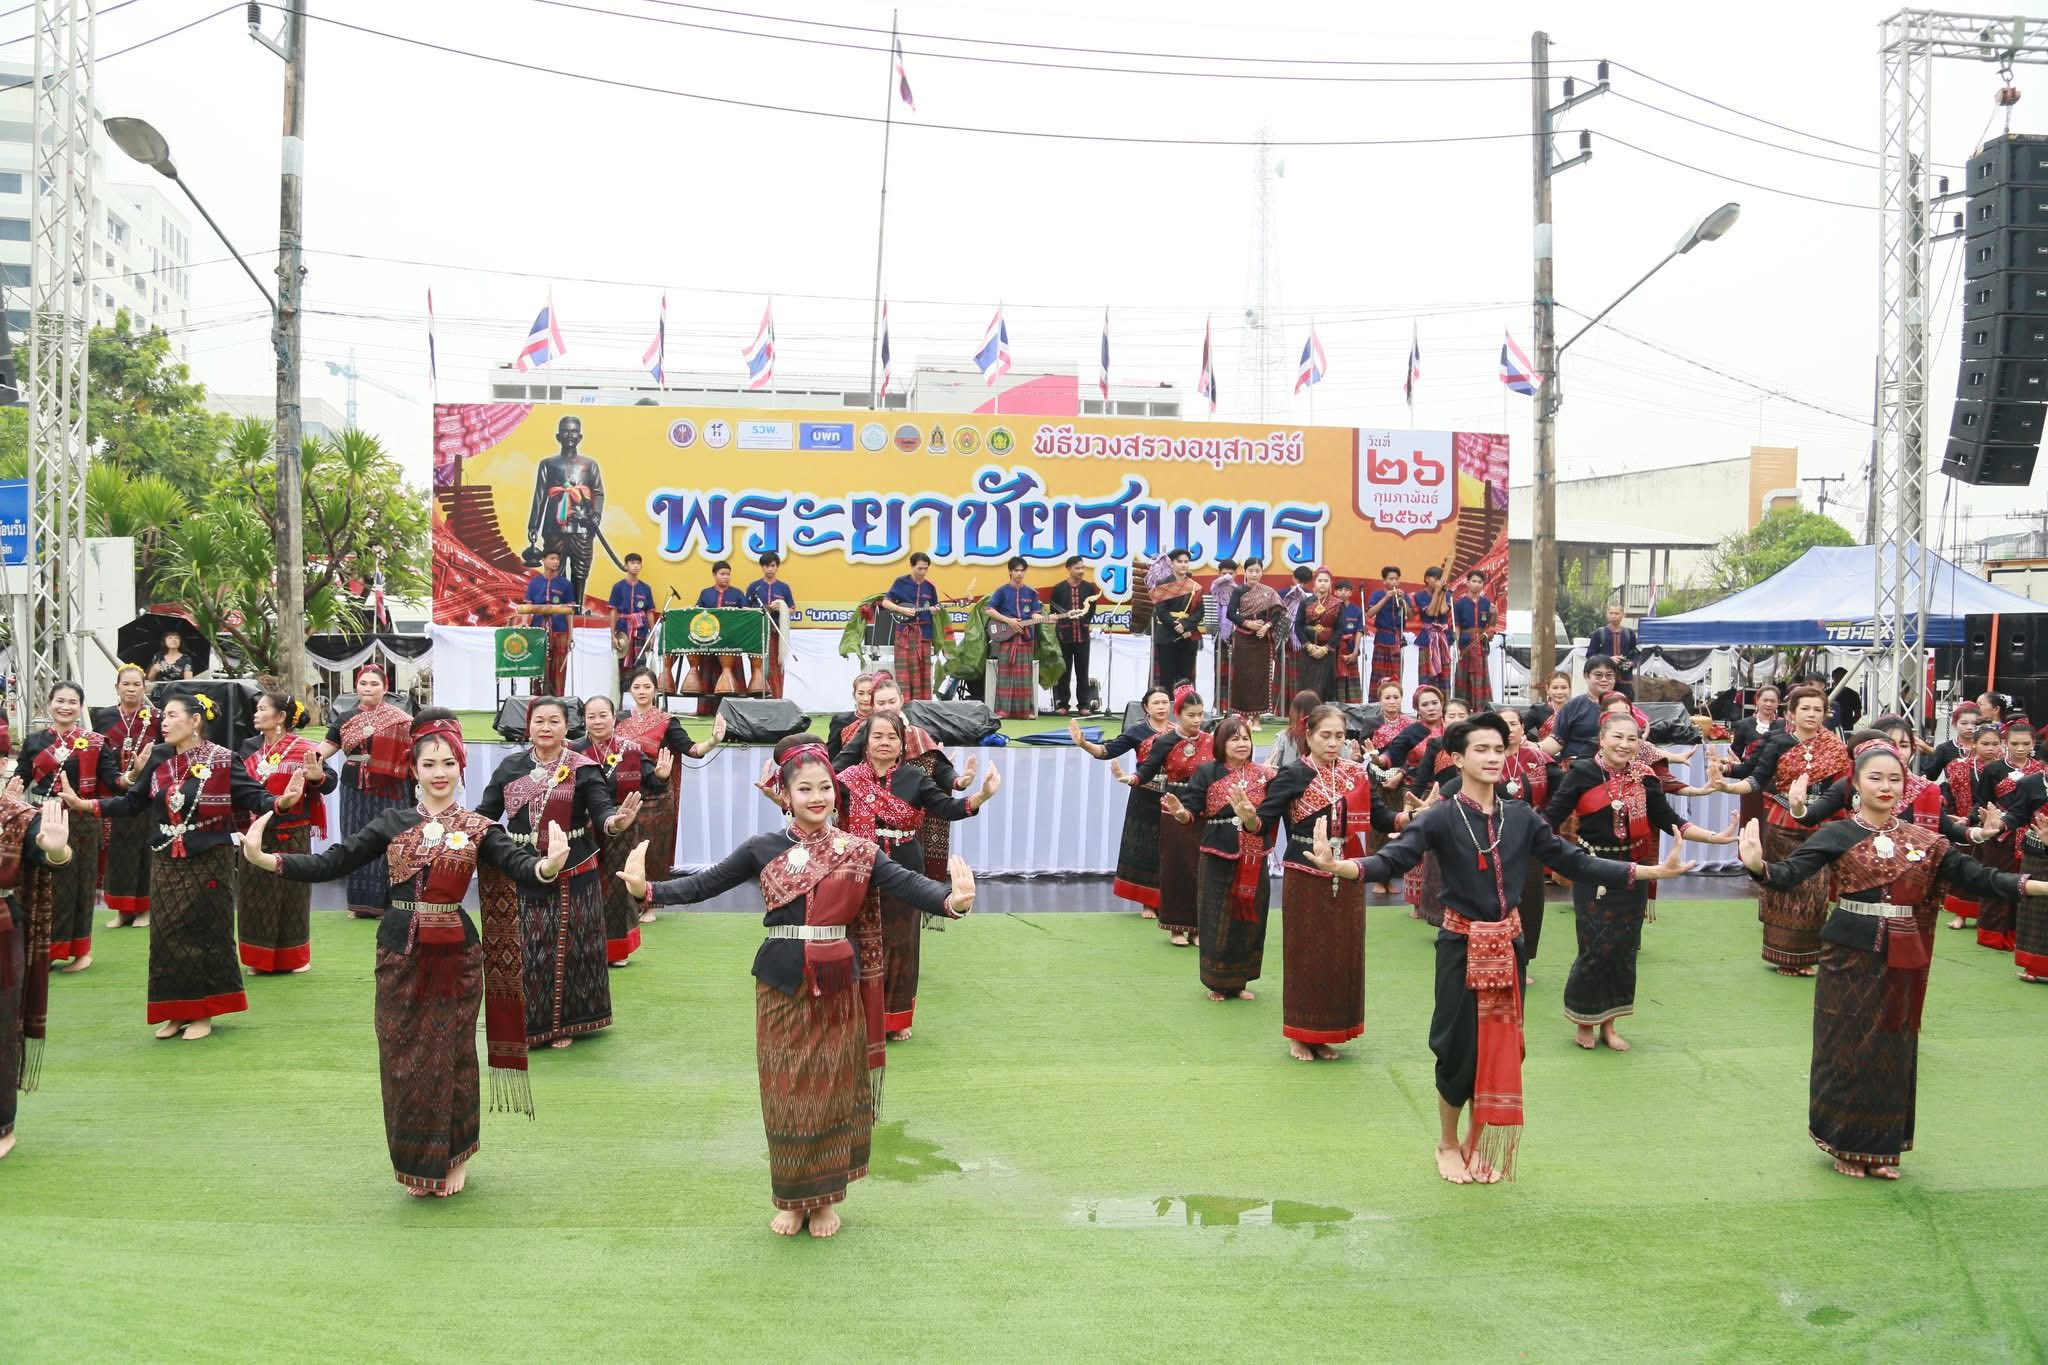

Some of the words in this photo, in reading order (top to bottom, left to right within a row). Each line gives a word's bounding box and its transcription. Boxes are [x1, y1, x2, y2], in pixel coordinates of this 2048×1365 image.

[1034, 427, 1302, 468] พิธีบวงสรวงอนุสาวรีย์
[1368, 431, 1391, 447] วันที่
[1366, 448, 1445, 486] ๒๖
[1373, 489, 1440, 507] กุมภาพันธ์
[1380, 509, 1434, 524] ๒๕๖๙
[651, 470, 1324, 595] พระยาชัยสุนทร
